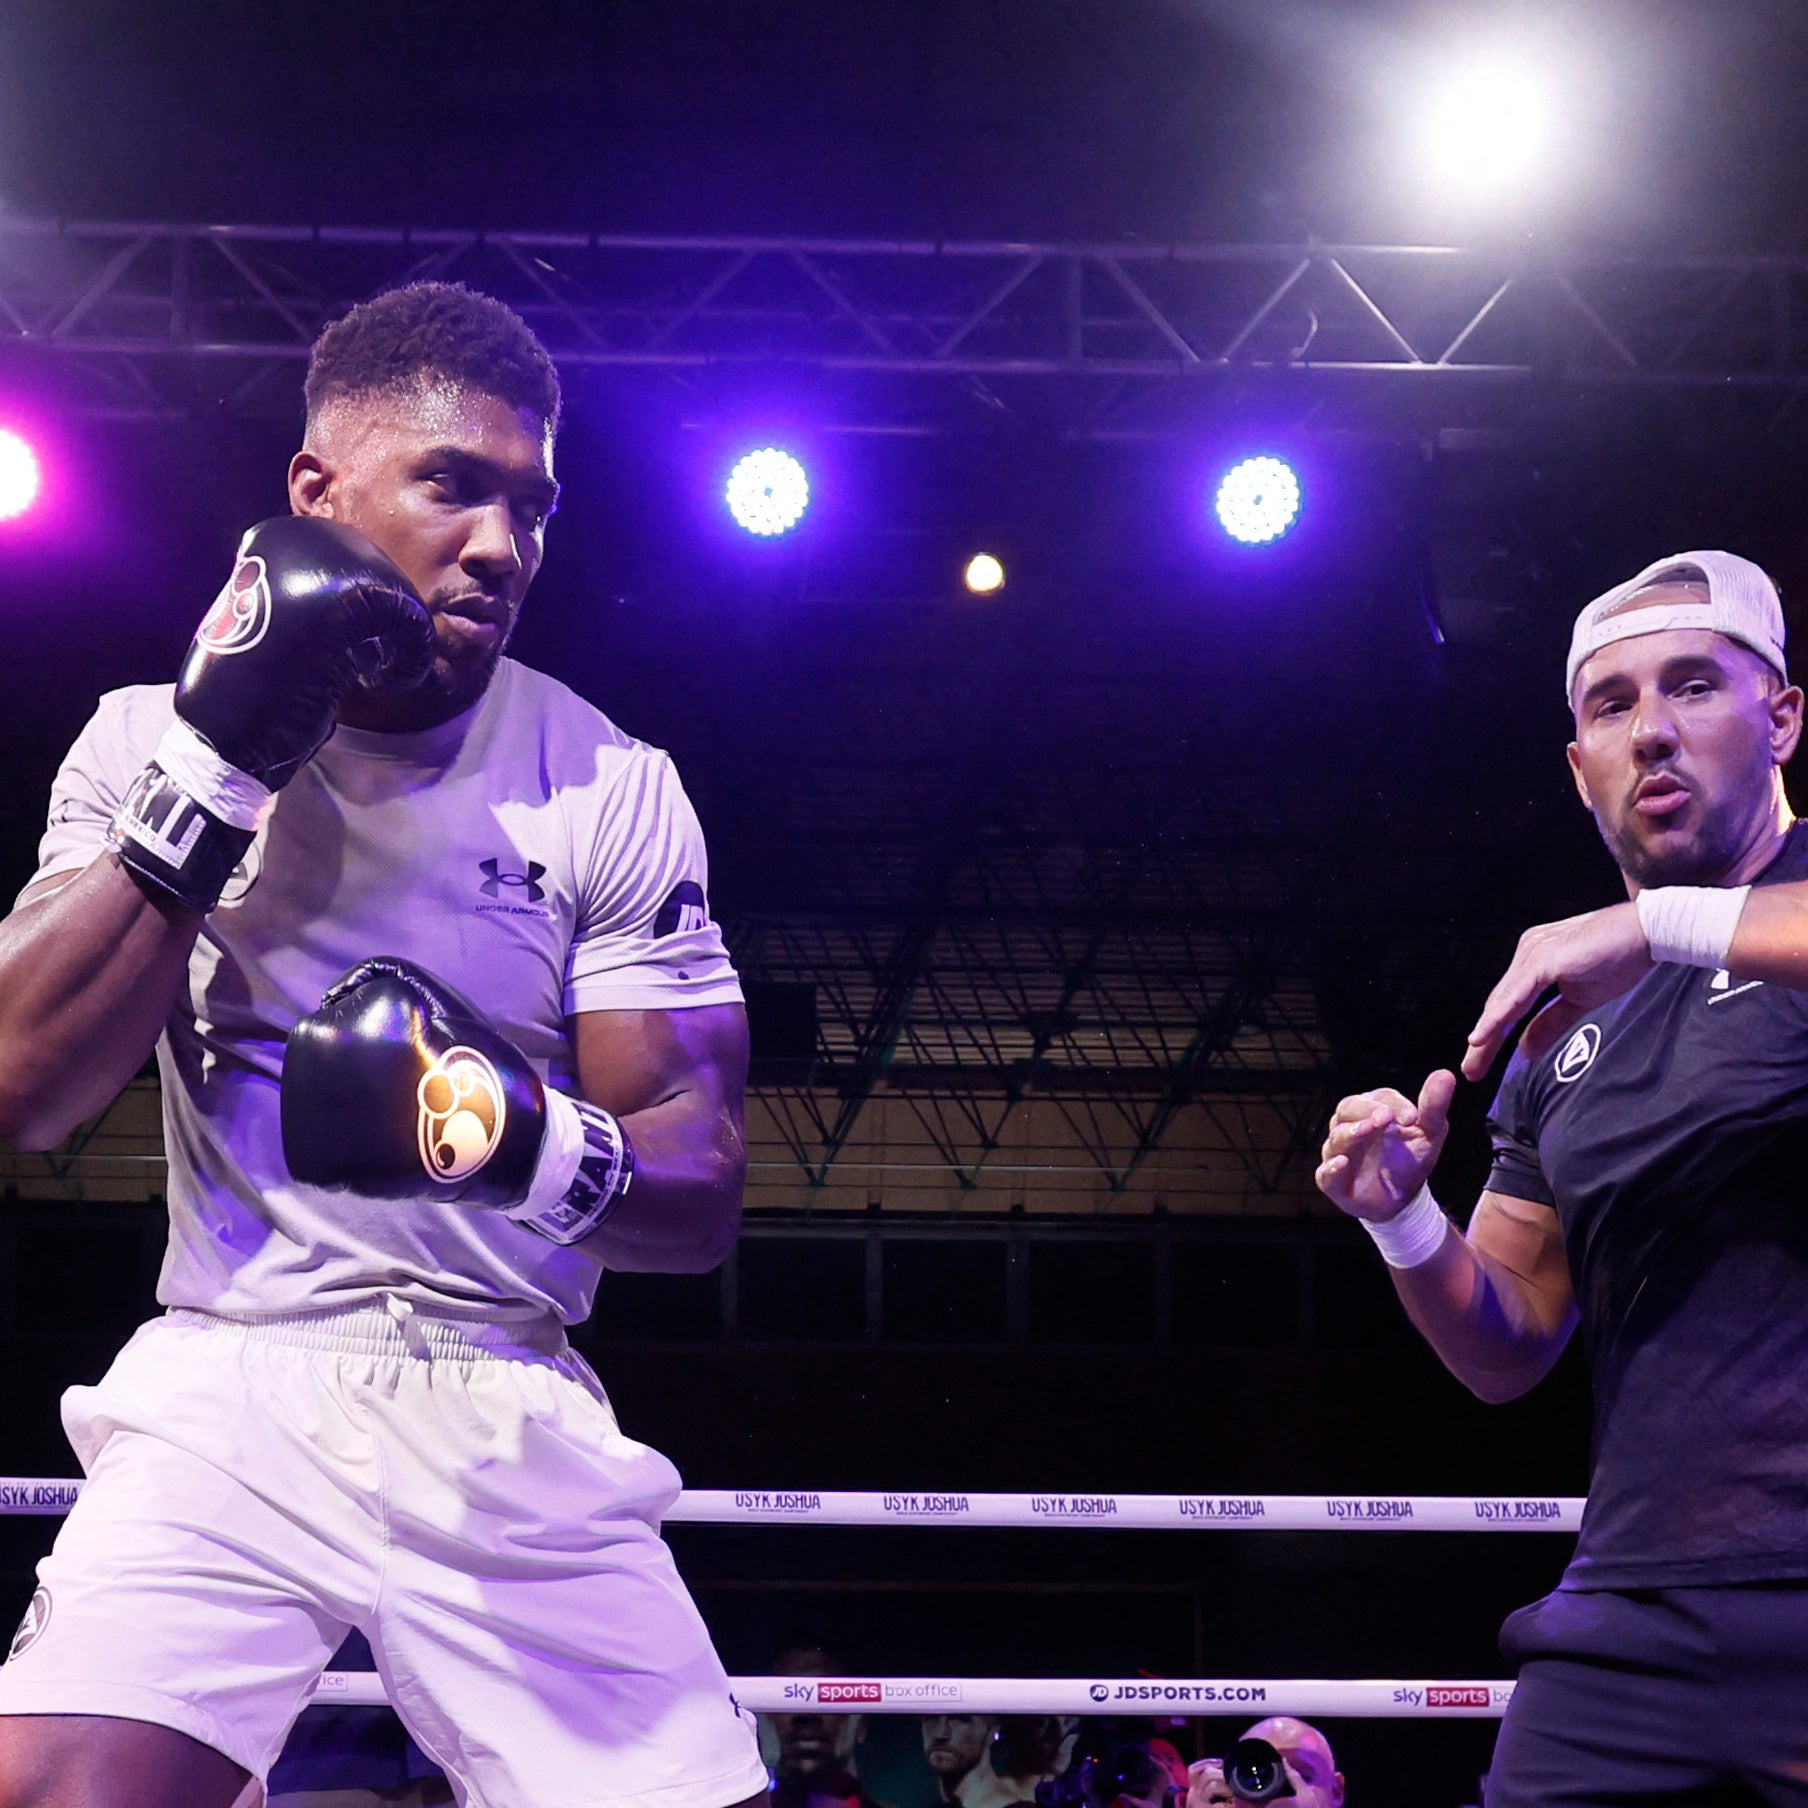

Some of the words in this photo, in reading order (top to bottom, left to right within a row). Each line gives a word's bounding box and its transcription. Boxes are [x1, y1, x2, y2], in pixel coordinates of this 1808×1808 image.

[476, 904, 510, 914] UNDER
[31, 1487, 79, 1507] JOSHUA
[735, 1492, 771, 1508] USYK
[883, 1495, 919, 1512] USYK
[1031, 1497, 1067, 1514] USYK
[1179, 1499, 1215, 1516] USYK
[1327, 1500, 1362, 1518] USYK
[1475, 1501, 1511, 1518] USYK
[784, 1683, 814, 1701] sky
[821, 1685, 880, 1703] sports
[886, 1684, 912, 1697] box
[915, 1683, 958, 1698] office
[1114, 1686, 1267, 1702] JDSPORTS.COM
[1393, 1688, 1423, 1706] sky
[1429, 1688, 1488, 1706] sports
